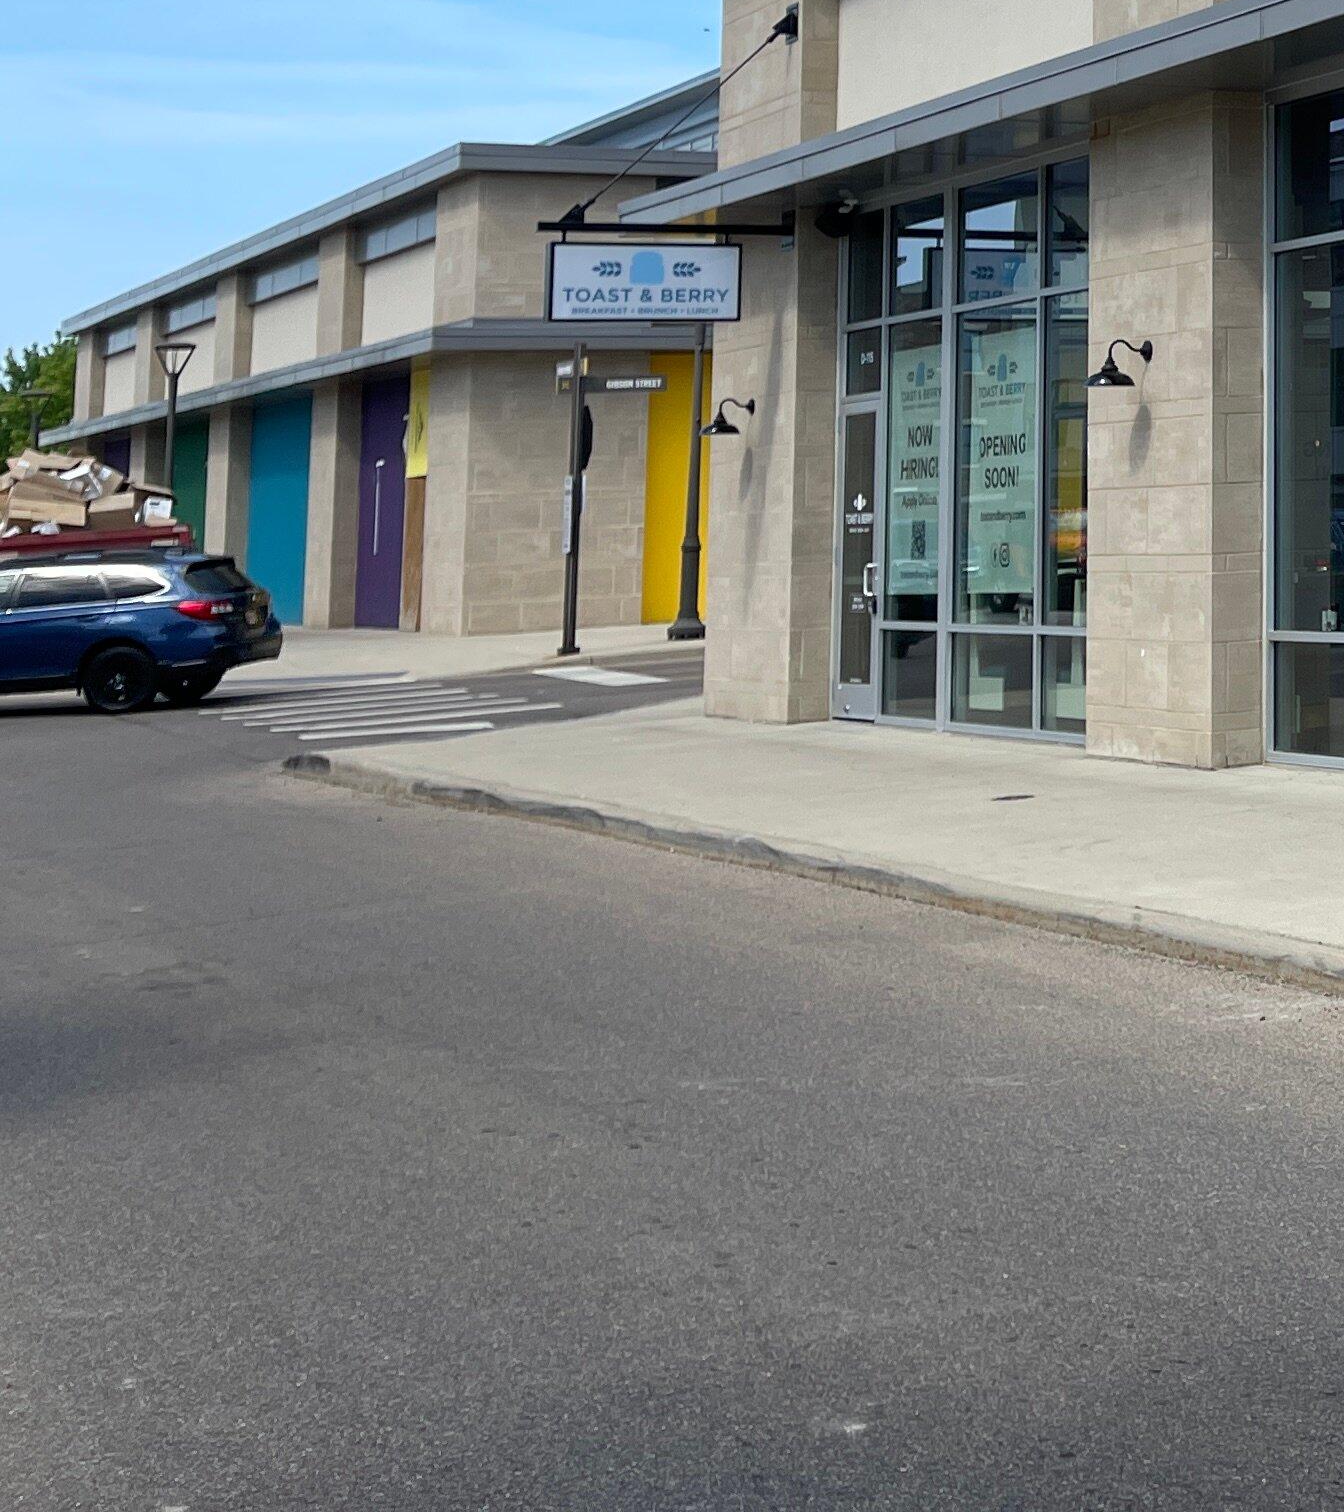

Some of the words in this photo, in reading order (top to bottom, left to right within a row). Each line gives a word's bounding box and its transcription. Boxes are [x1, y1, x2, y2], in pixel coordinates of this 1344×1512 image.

[562, 288, 633, 303] TOAST
[639, 288, 653, 303] &
[660, 288, 730, 303] BERRY
[571, 307, 628, 315] BREAKFAST
[637, 307, 678, 315] BRUNCH
[686, 307, 719, 315] LUNCH
[635, 378, 662, 389] STREET
[907, 425, 933, 448] NOW
[979, 433, 1026, 458] OPENING
[984, 466, 1020, 489] SOON!
